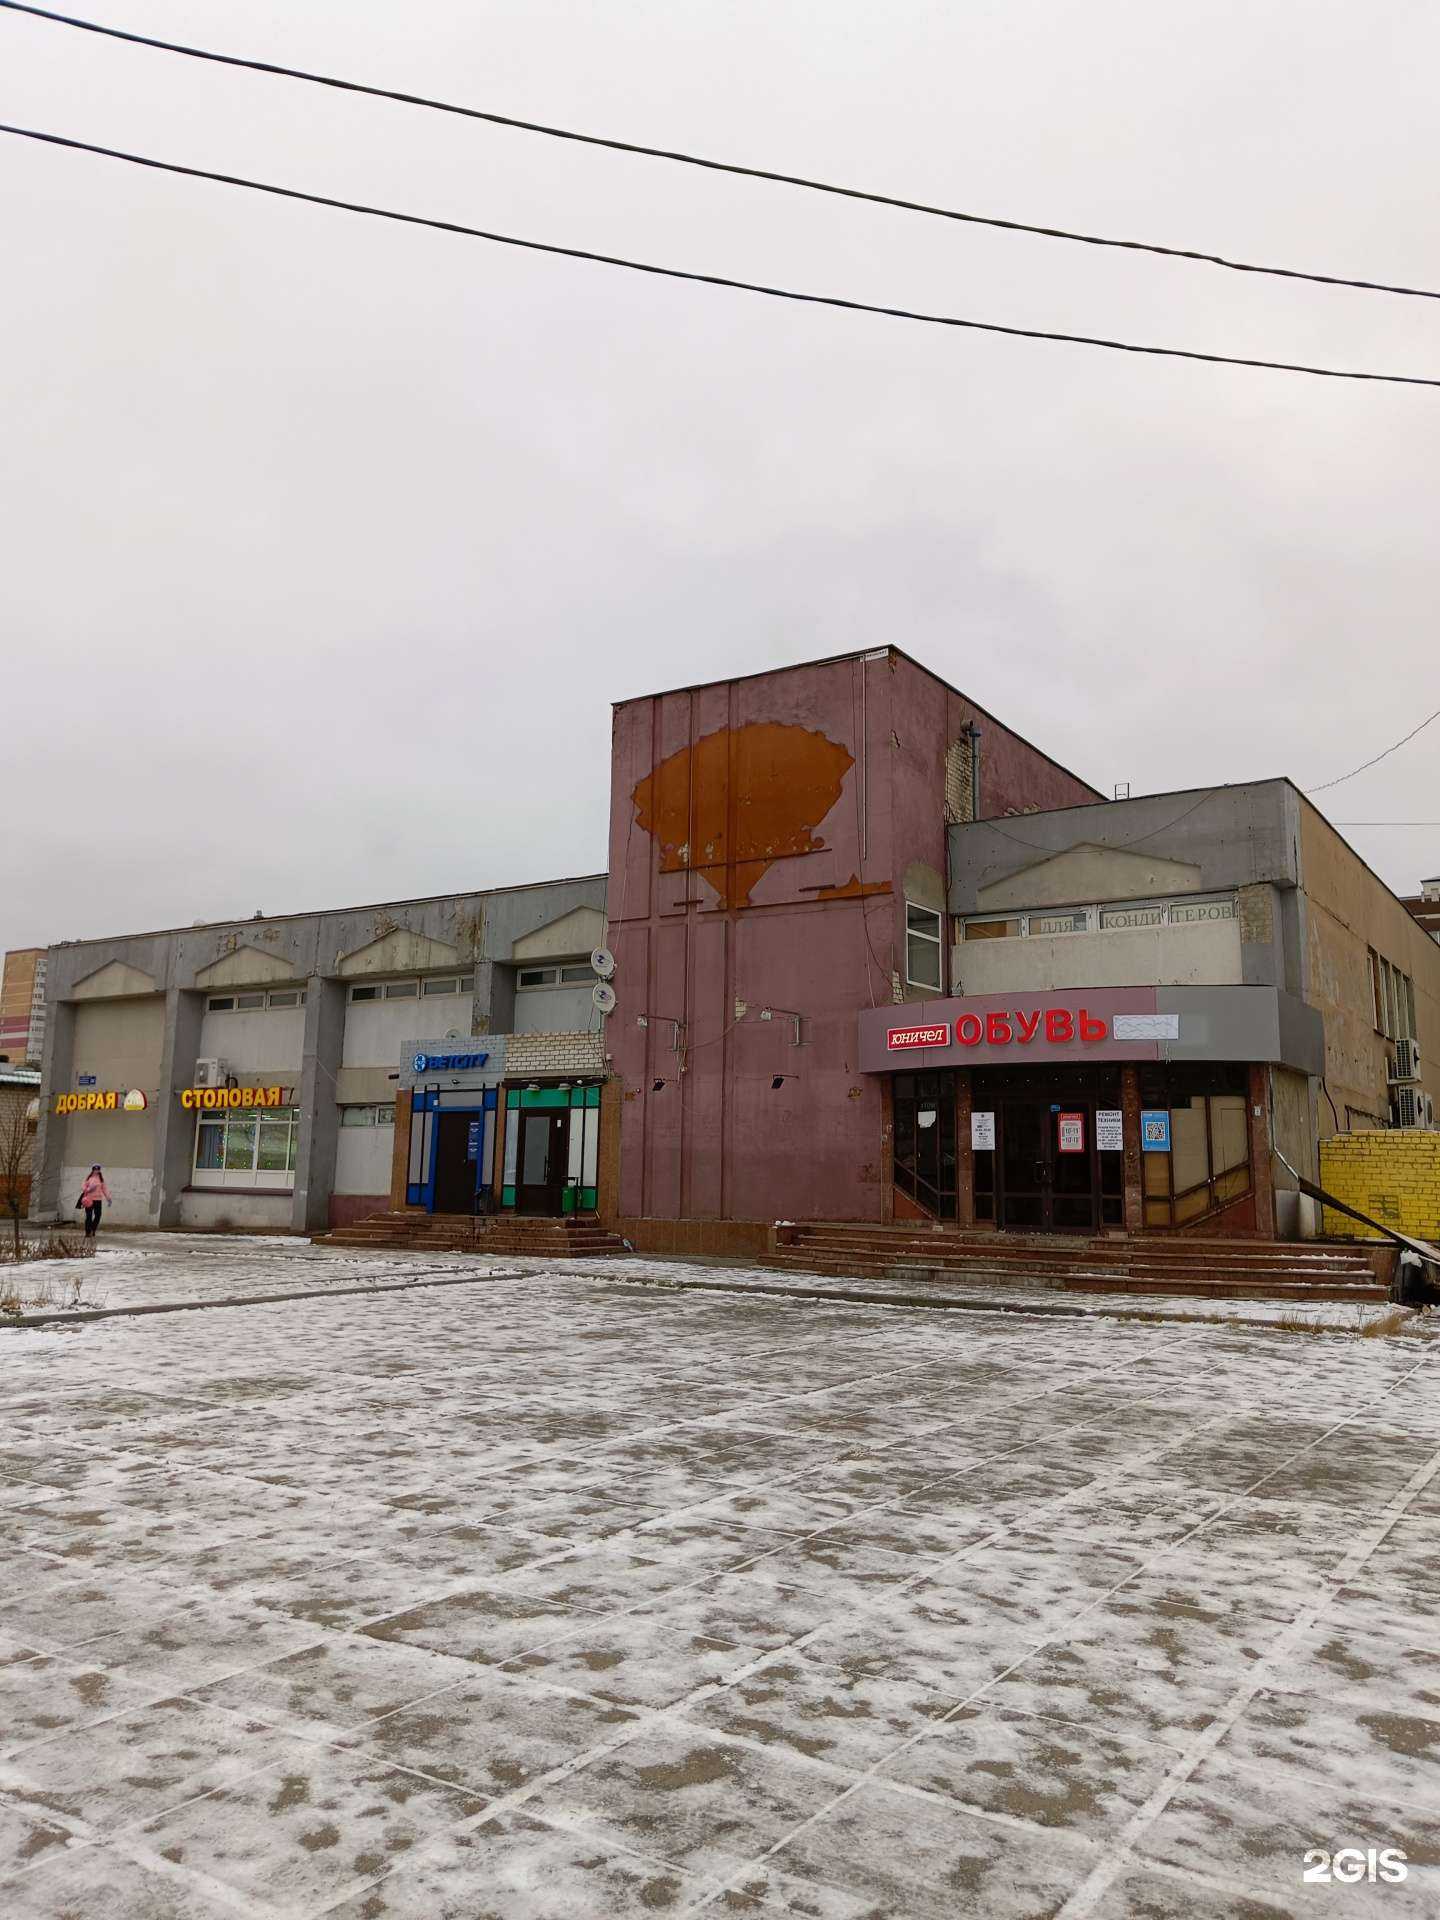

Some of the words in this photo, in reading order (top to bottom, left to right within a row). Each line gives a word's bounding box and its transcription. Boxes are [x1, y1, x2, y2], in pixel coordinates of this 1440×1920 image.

[956, 1009, 1108, 1046] ОБУВЬ
[427, 1054, 489, 1069] BETCITY
[55, 1090, 117, 1114] ДОБРАЯ
[181, 1087, 284, 1109] СТОЛОВАЯ
